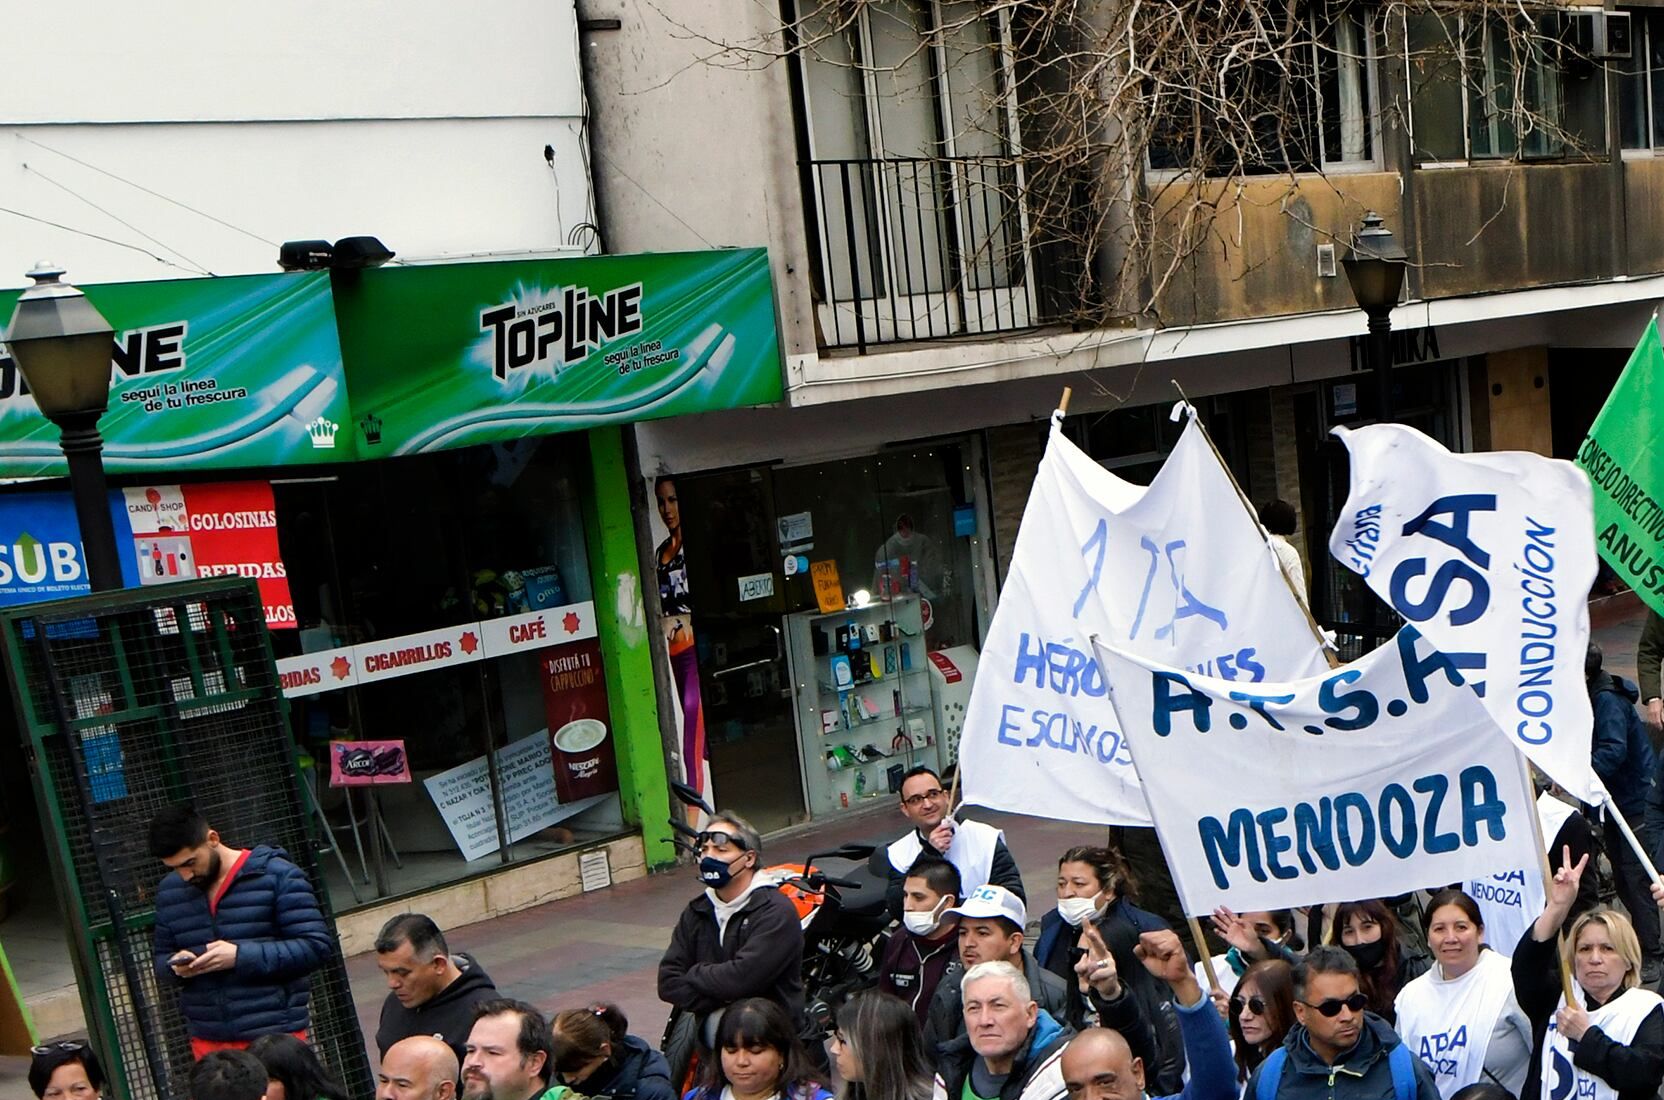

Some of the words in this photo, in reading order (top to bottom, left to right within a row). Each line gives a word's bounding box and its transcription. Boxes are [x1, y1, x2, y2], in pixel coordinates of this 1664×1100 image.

[619, 362, 632, 375] de
[632, 359, 643, 371] tu
[643, 349, 679, 368] frescura
[630, 345, 640, 358] la
[164, 380, 177, 393] la
[145, 400, 163, 412] de
[167, 398, 182, 409] tu
[186, 388, 247, 405] frescura
[160, 502, 184, 512] SHOP
[190, 511, 277, 531] GOLOSINAS
[365, 640, 452, 673] CIGARRILLOS
[509, 616, 546, 645] CAFÉ
[1197, 764, 1508, 891] MENDOZA
[1471, 881, 1522, 909] MENDOZA
